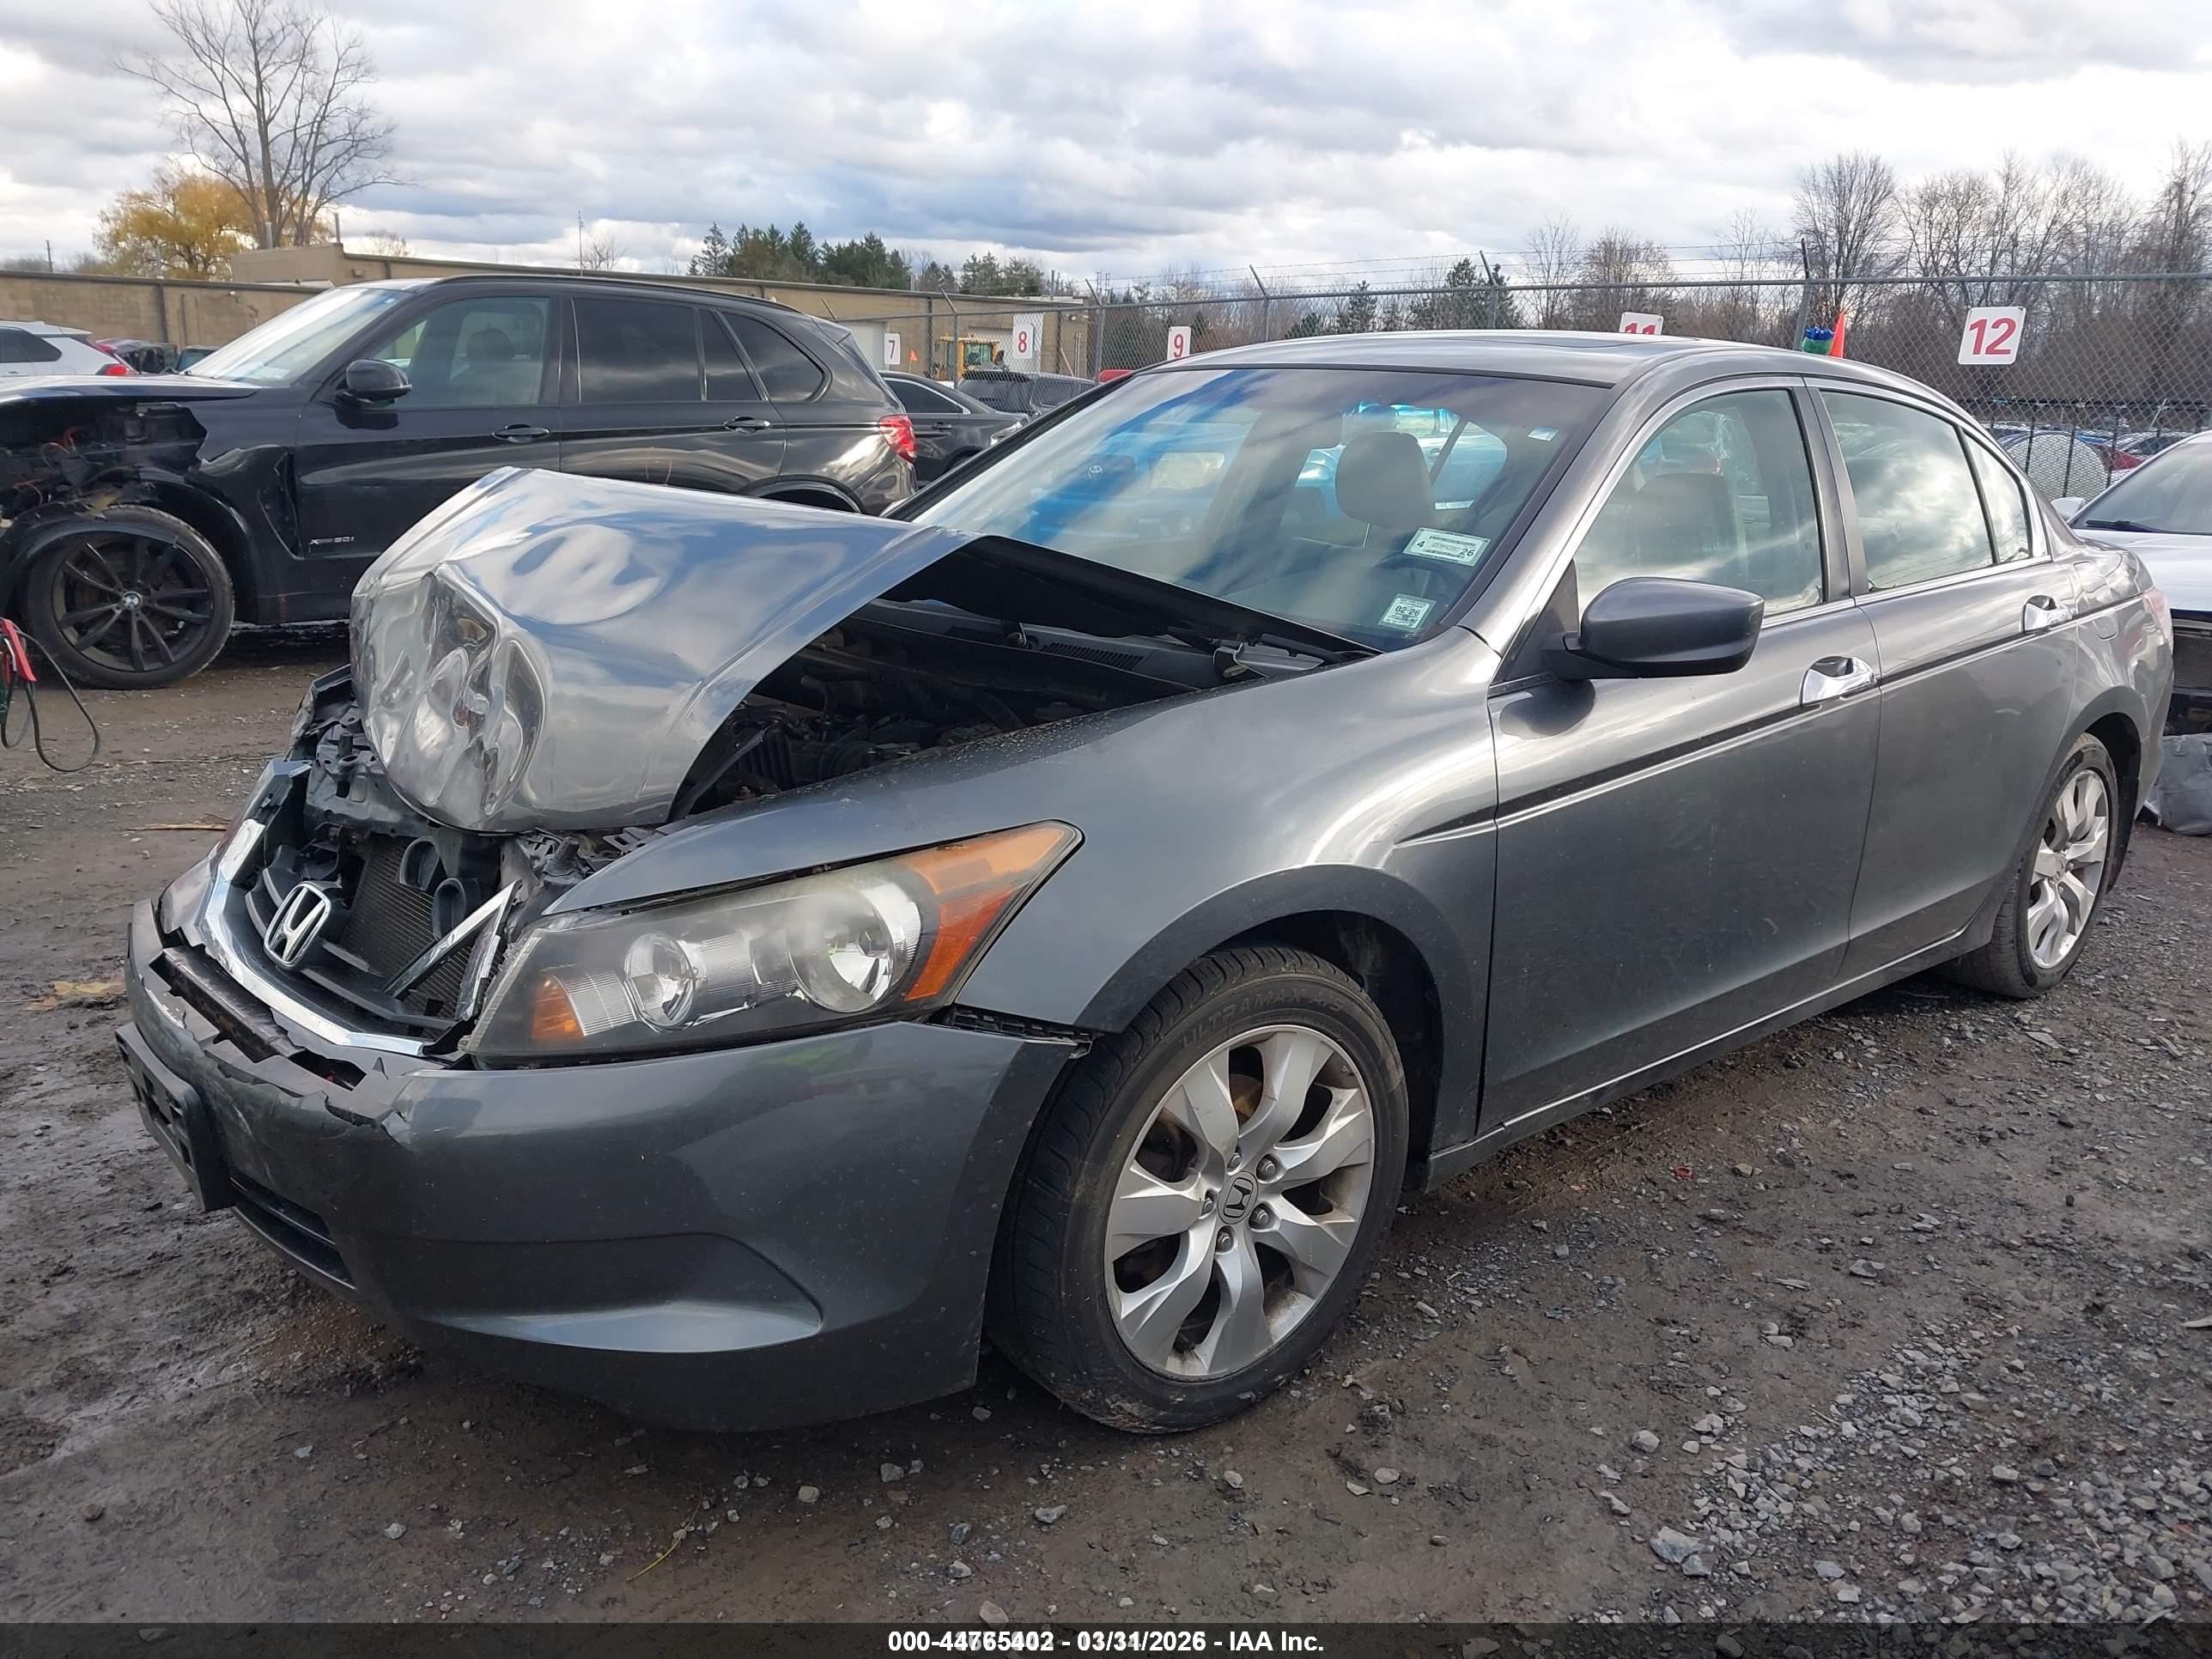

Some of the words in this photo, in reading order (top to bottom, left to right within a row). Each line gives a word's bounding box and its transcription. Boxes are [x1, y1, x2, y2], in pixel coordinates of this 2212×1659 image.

[1018, 331, 1028, 354] 8
[1173, 333, 1184, 358] 9
[1969, 317, 2017, 356] 12
[888, 339, 896, 360] 7
[1459, 548, 1476, 557] 26
